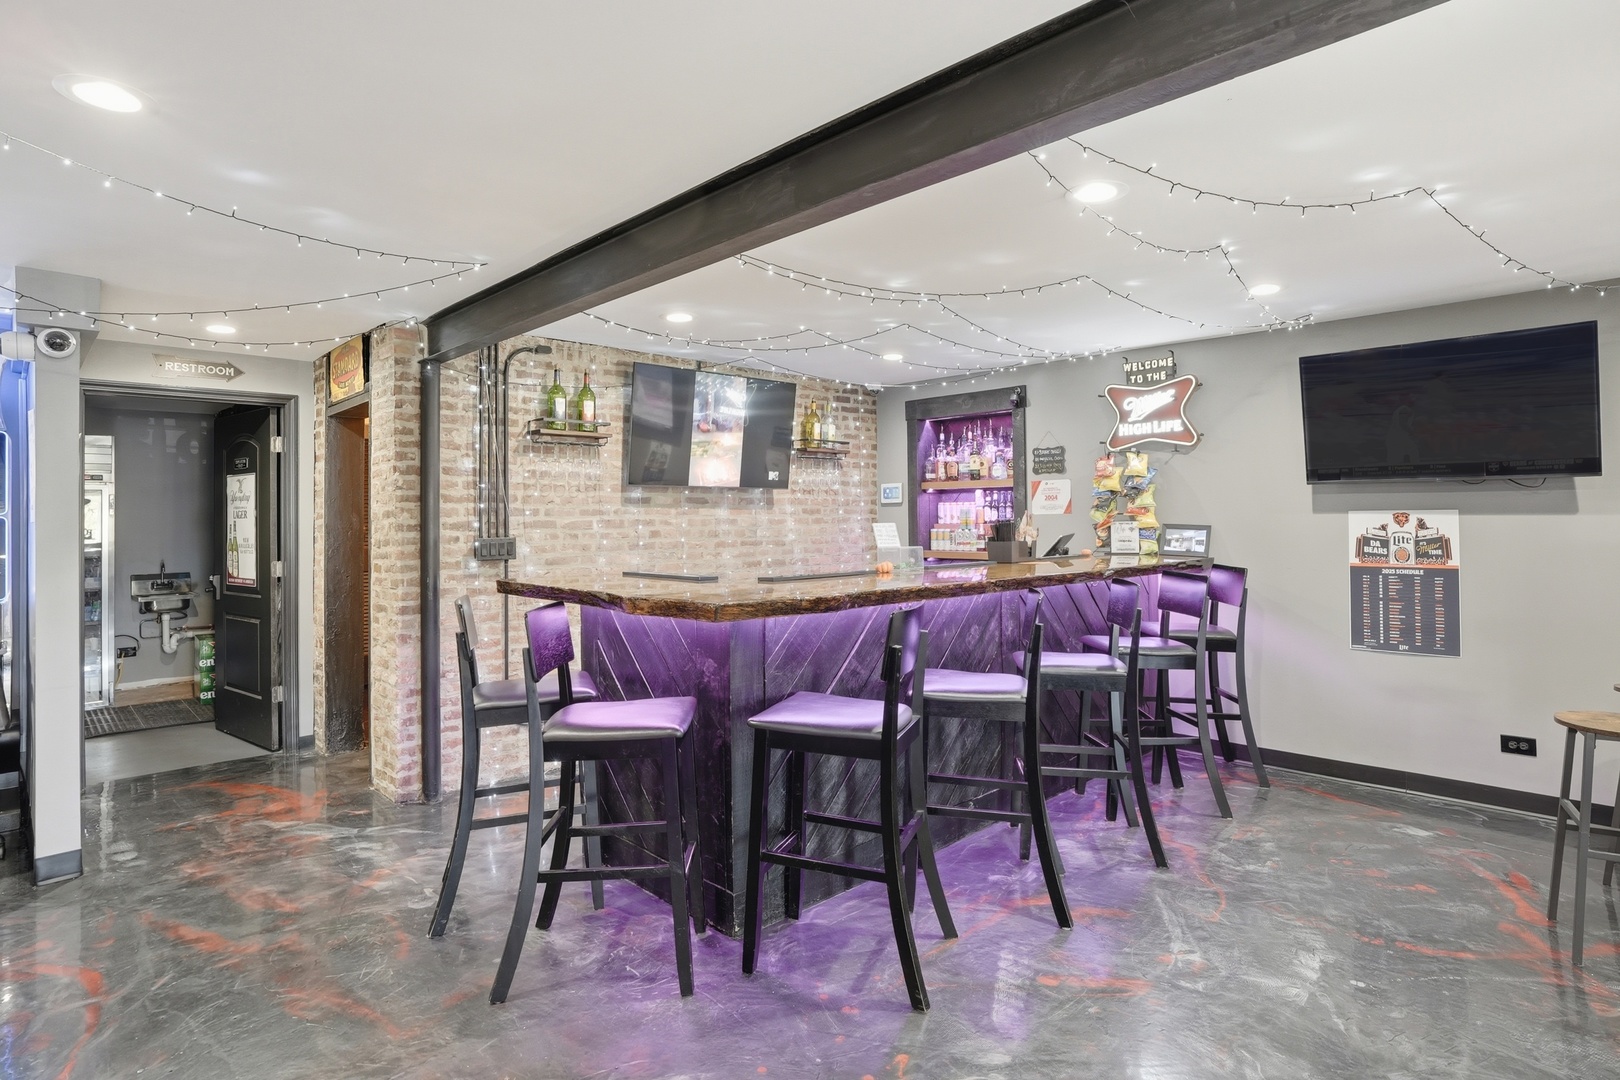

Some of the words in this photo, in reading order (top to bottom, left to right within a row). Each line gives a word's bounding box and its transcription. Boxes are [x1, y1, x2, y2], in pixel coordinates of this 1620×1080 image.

[165, 361, 234, 376] RESTROOM
[1123, 357, 1174, 372] WELCOME
[1130, 375, 1143, 383] TO
[1146, 371, 1167, 381] THE
[1118, 422, 1151, 437] HIGH
[1152, 419, 1184, 433] LIFE
[232, 510, 248, 519] LAGER
[1392, 535, 1412, 546] Lite
[1363, 546, 1388, 555] BEARS
